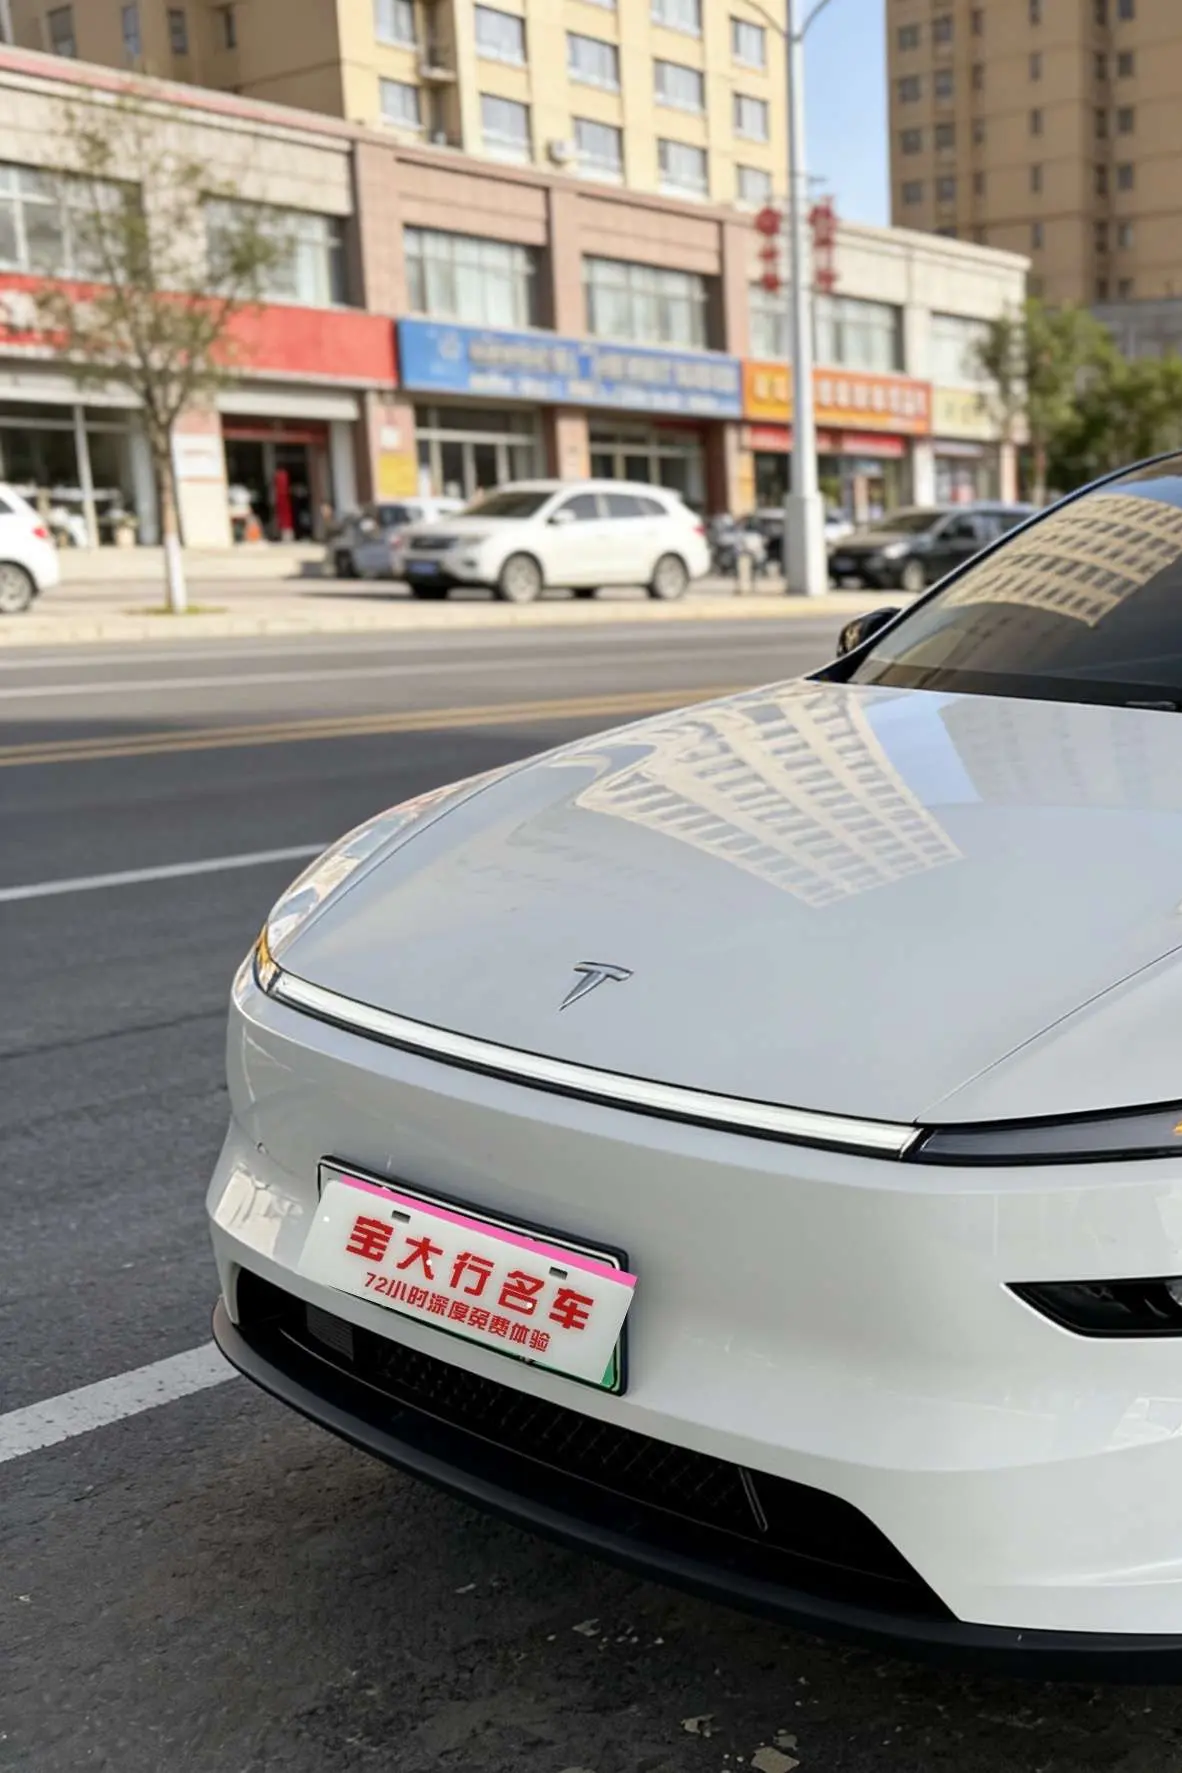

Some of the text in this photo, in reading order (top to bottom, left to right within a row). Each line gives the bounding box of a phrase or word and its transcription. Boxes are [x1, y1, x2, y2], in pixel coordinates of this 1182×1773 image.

[345, 1215, 595, 1330] 宝大行名车
[365, 1271, 550, 1352] 72小时深度免费体验
